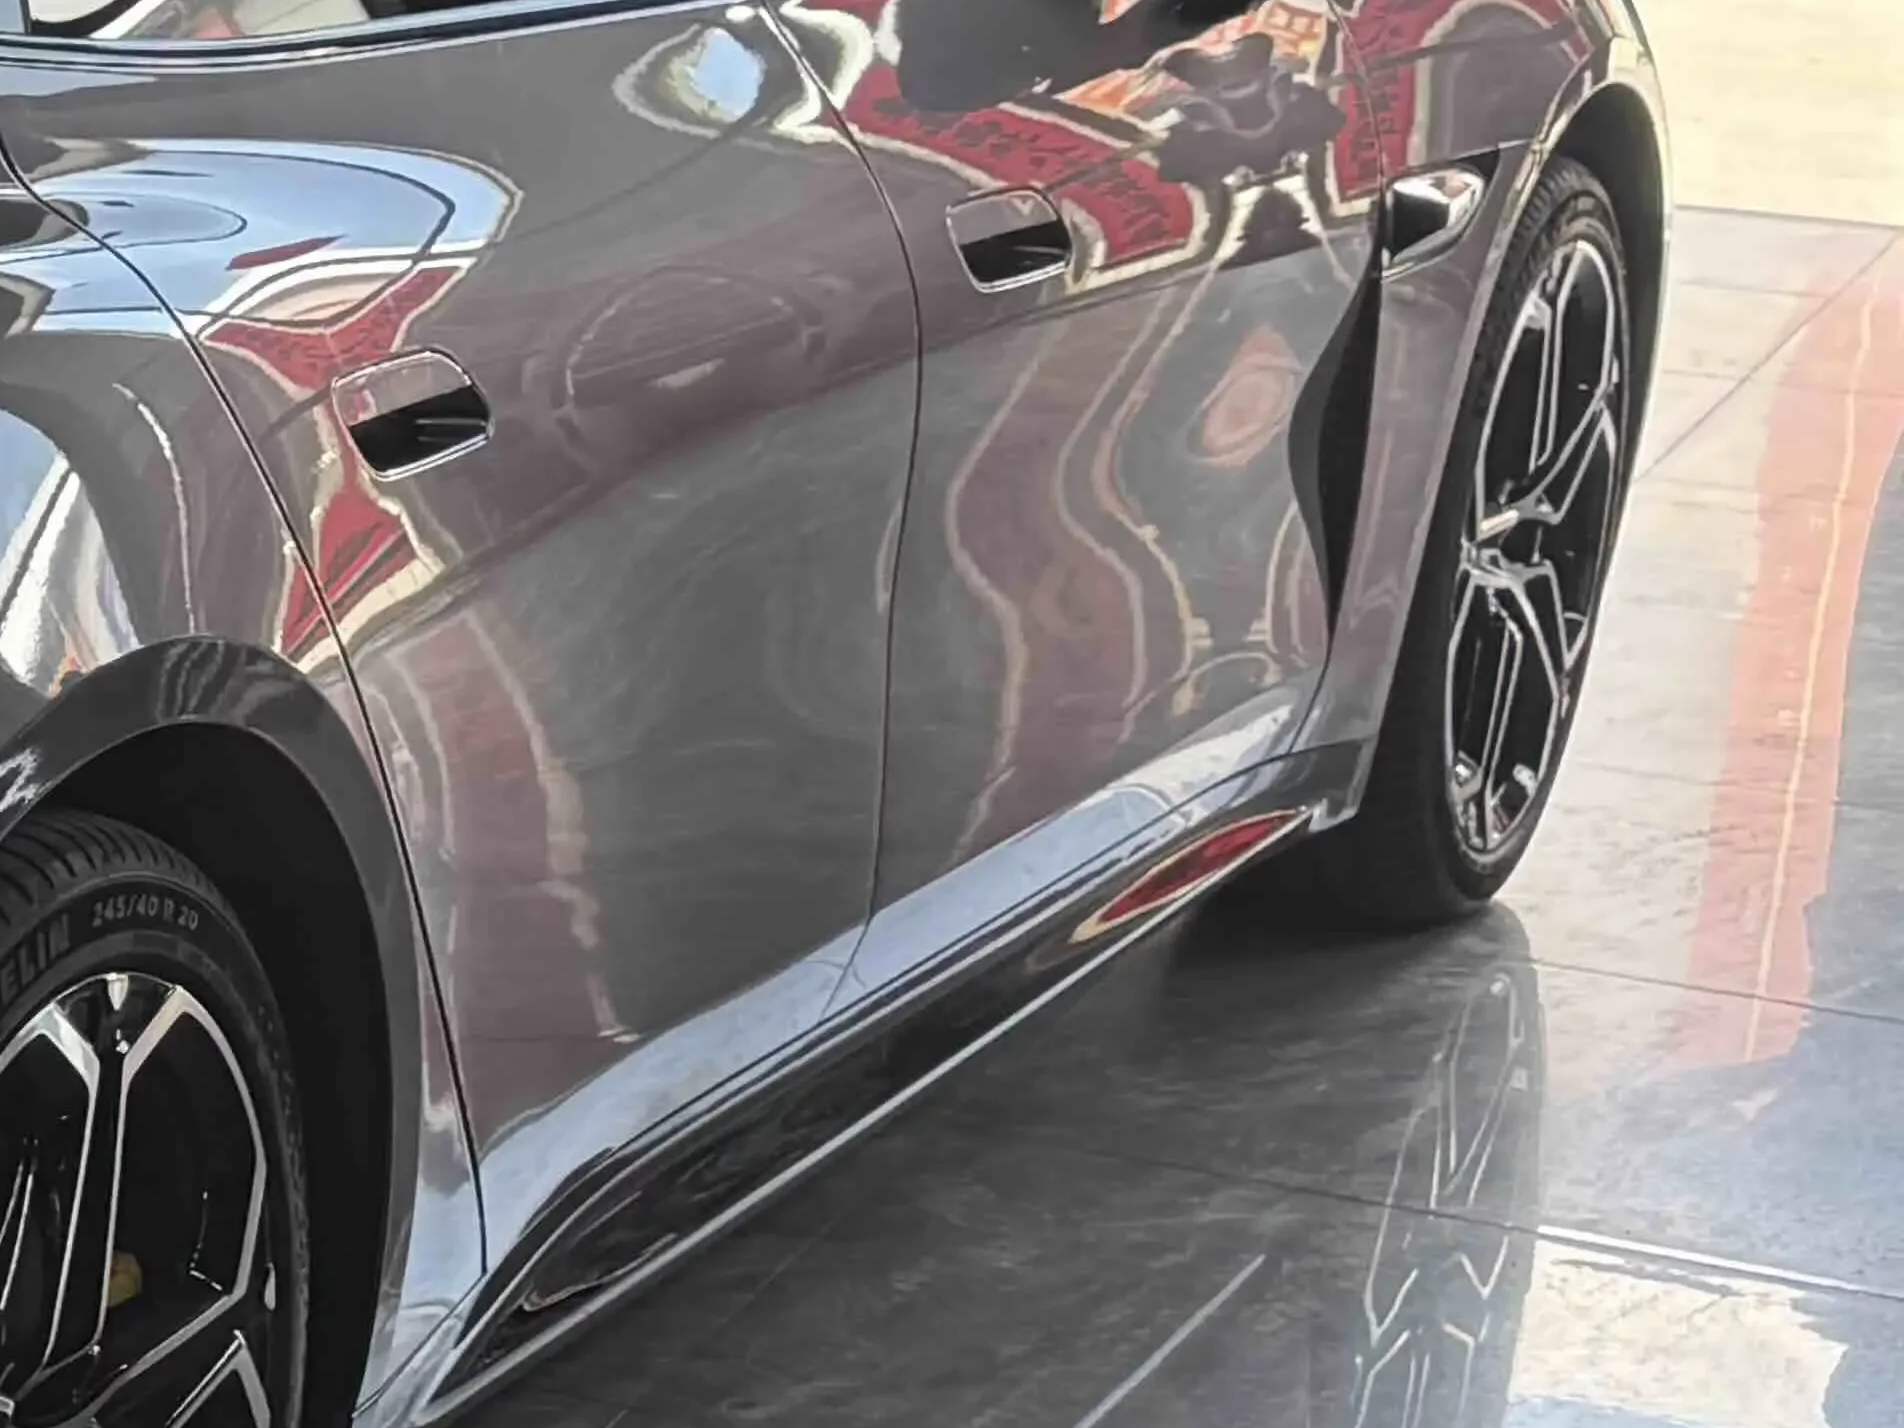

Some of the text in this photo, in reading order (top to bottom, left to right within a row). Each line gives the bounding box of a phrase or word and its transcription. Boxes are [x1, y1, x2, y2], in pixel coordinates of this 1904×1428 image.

[92, 892, 200, 931] 245/40 R 20
